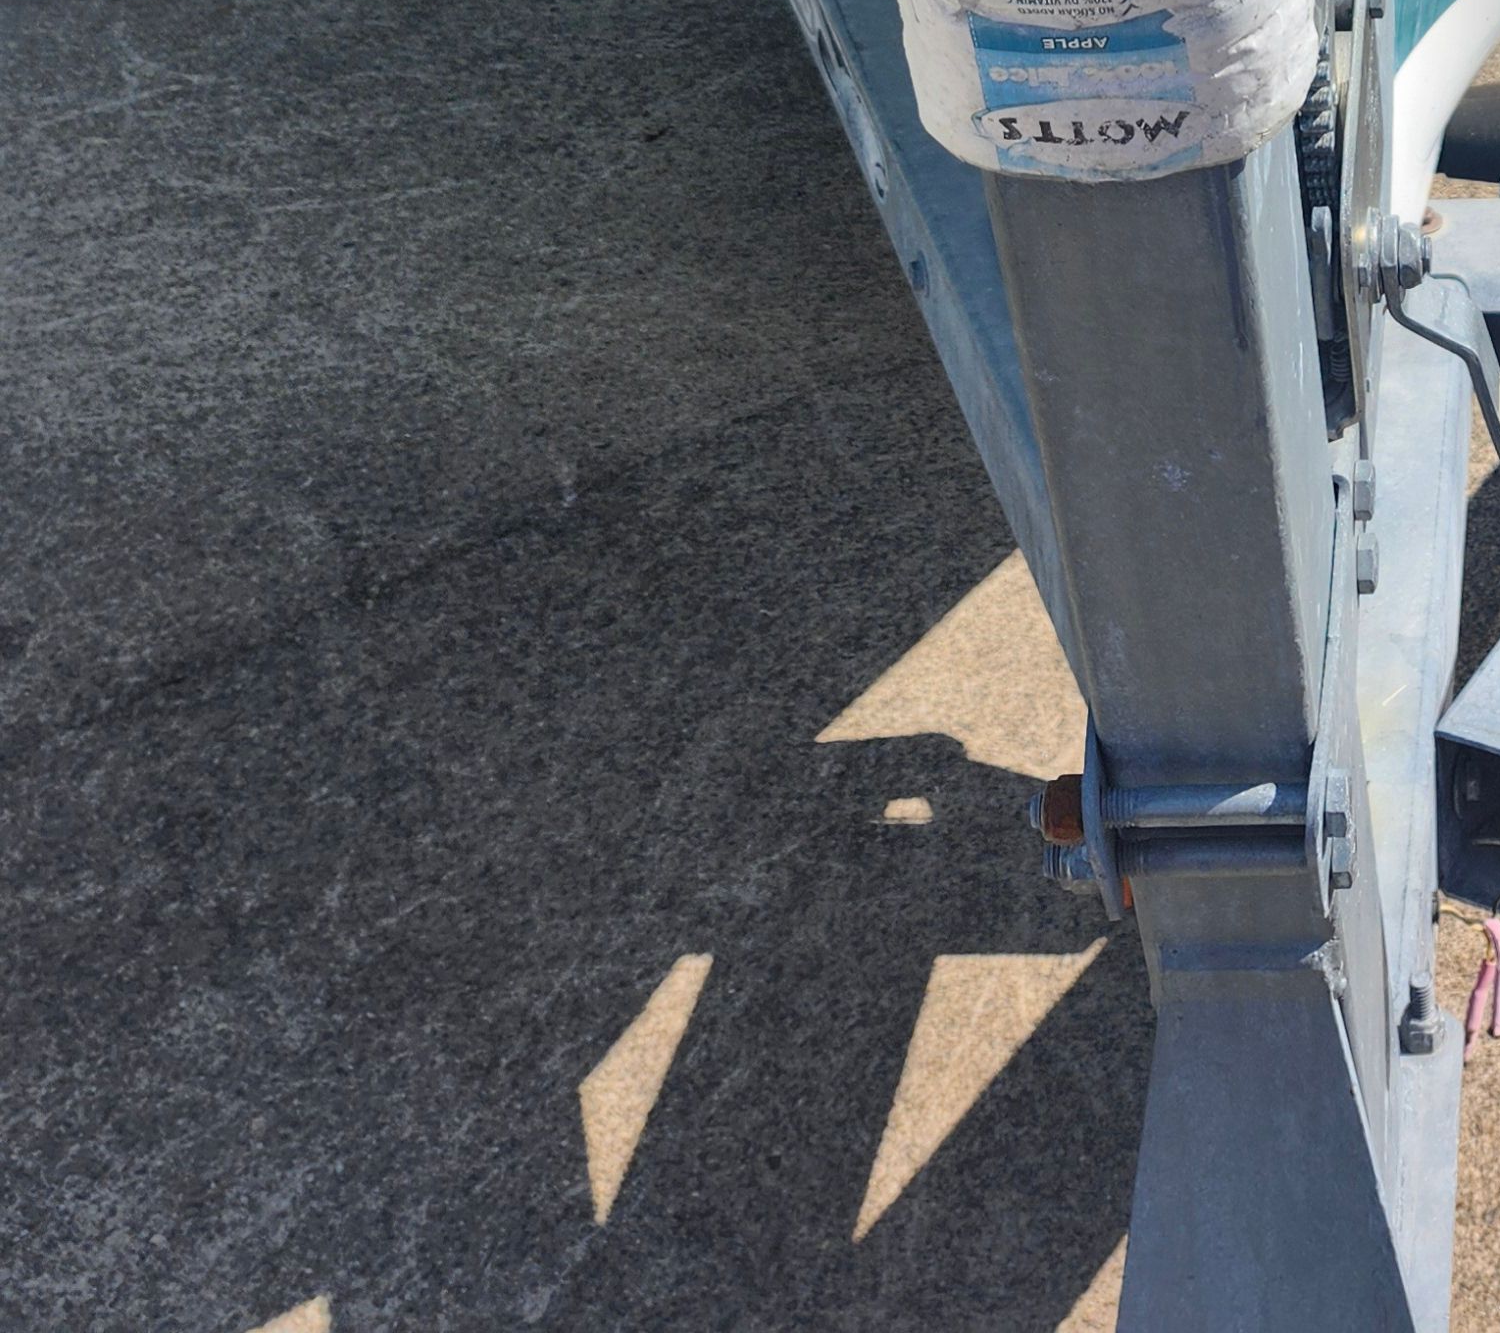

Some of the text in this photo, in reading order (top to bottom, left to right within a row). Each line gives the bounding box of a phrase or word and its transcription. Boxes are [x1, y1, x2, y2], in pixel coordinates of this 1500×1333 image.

[1017, 6, 1115, 17] NO SUGAR ADDED
[1042, 38, 1108, 49] APPLE
